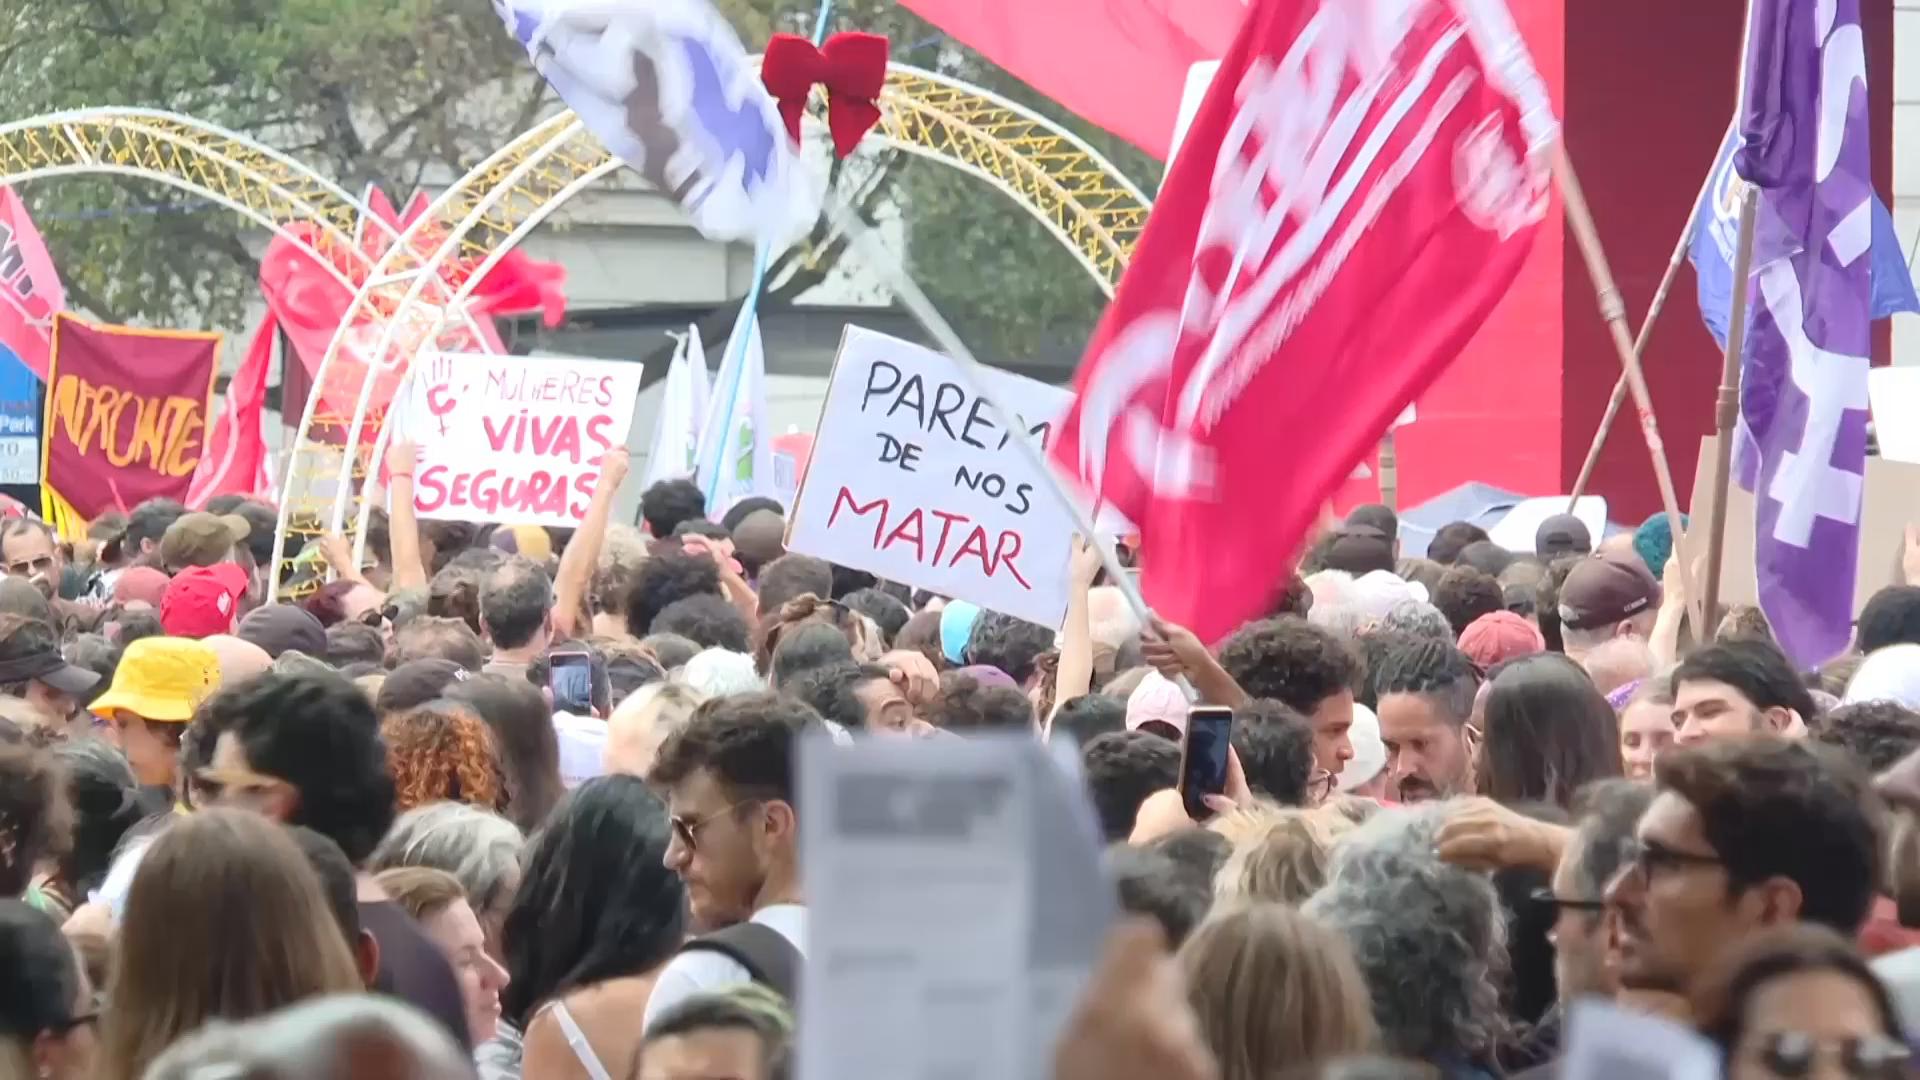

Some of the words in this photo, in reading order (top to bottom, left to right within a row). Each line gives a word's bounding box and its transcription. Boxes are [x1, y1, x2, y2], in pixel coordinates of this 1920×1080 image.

[414, 465, 601, 520] SEGURAS
[876, 431, 924, 473] DE
[954, 465, 1034, 515] NOS
[826, 485, 1032, 590] MATAR
